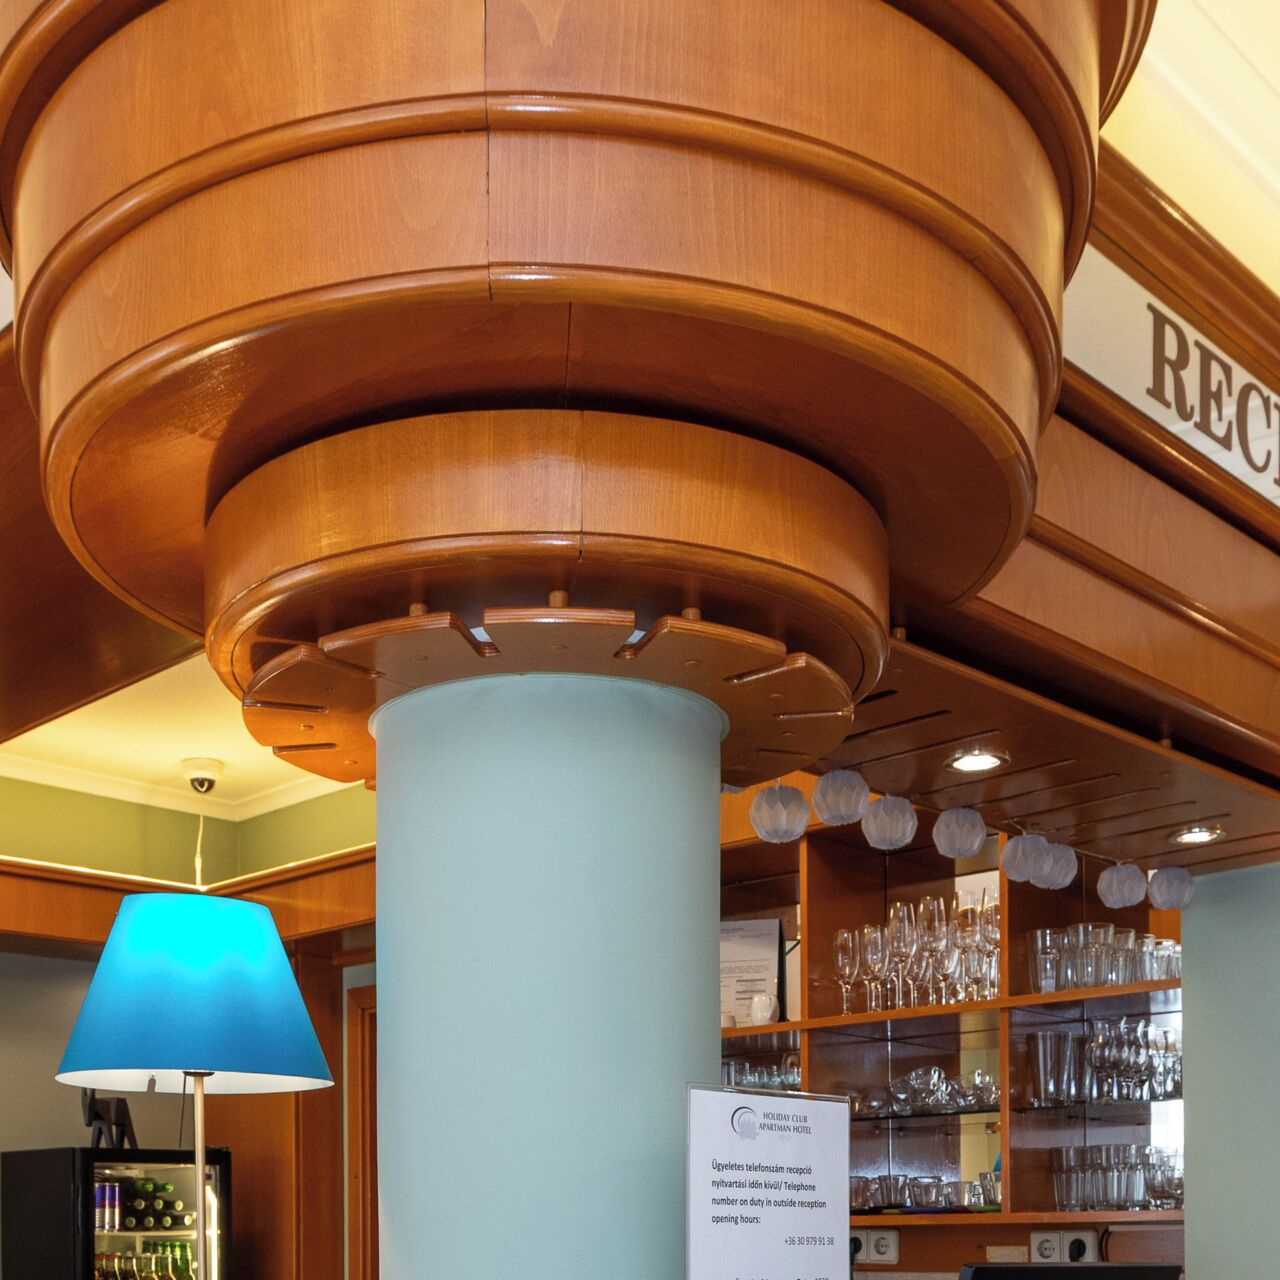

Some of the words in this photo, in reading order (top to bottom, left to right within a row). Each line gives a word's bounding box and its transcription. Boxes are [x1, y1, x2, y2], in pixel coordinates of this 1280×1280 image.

[763, 1111, 790, 1121] HOLIDAY
[791, 1114, 808, 1123] CLUB
[758, 1122, 791, 1132] APARTMAN
[792, 1125, 812, 1135] HOTEL
[711, 1158, 744, 1172] Ügyeletes
[745, 1162, 785, 1173] telefonszám
[786, 1165, 812, 1176] recepció
[783, 1181, 816, 1192] Telephone
[711, 1196, 738, 1206] number
[739, 1198, 749, 1206] on
[749, 1197, 765, 1208] duty
[765, 1197, 772, 1207] in
[773, 1198, 797, 1208] outside
[797, 1199, 827, 1210] reception
[711, 1213, 739, 1225] opening
[740, 1213, 761, 1224] hours:
[784, 1236, 796, 1246] +36
[796, 1236, 805, 1246] 30
[805, 1236, 818, 1246] 979
[818, 1236, 826, 1246] 91
[826, 1236, 835, 1246] 38
